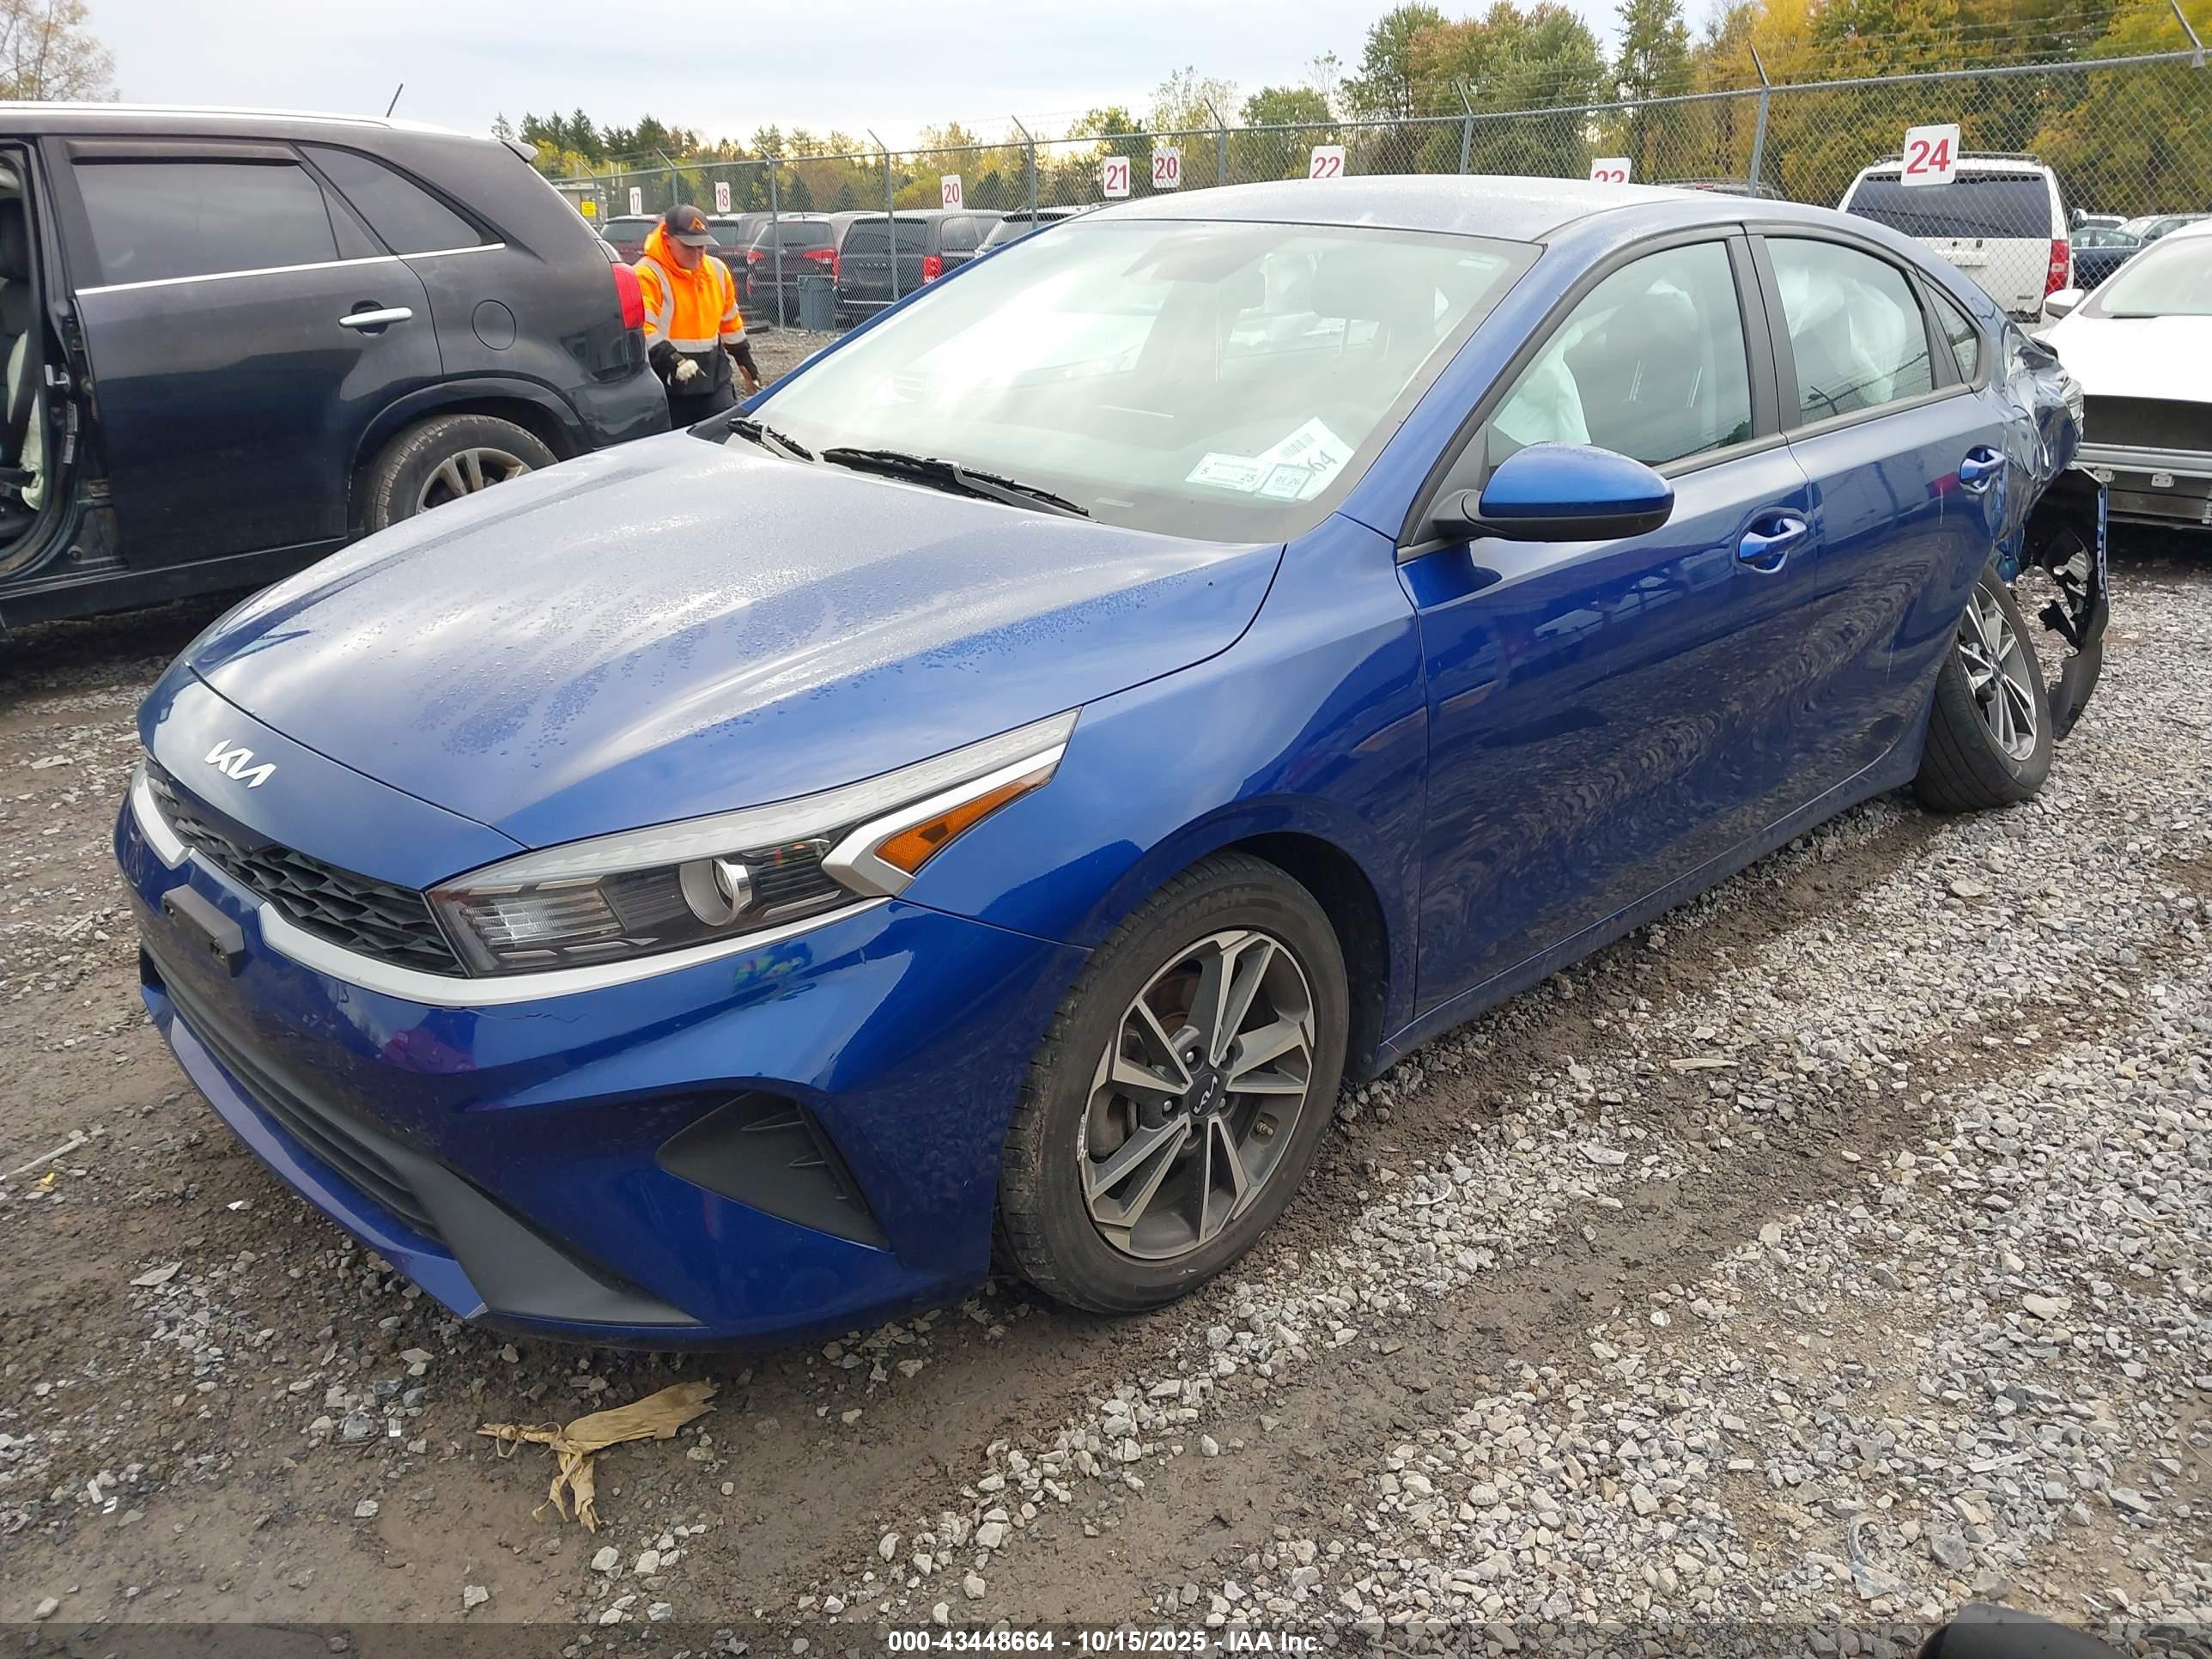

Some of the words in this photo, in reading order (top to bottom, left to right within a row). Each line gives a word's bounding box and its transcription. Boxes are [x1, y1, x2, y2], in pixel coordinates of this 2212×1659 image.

[1906, 137, 1951, 174] 24
[1106, 164, 1127, 191] 21
[1155, 156, 1178, 179] 20
[1312, 156, 1340, 179] 22
[631, 192, 640, 211] 17
[716, 187, 729, 208] 18
[944, 183, 960, 204] 20
[1297, 450, 1339, 476] 64
[204, 738, 276, 788] KIA
